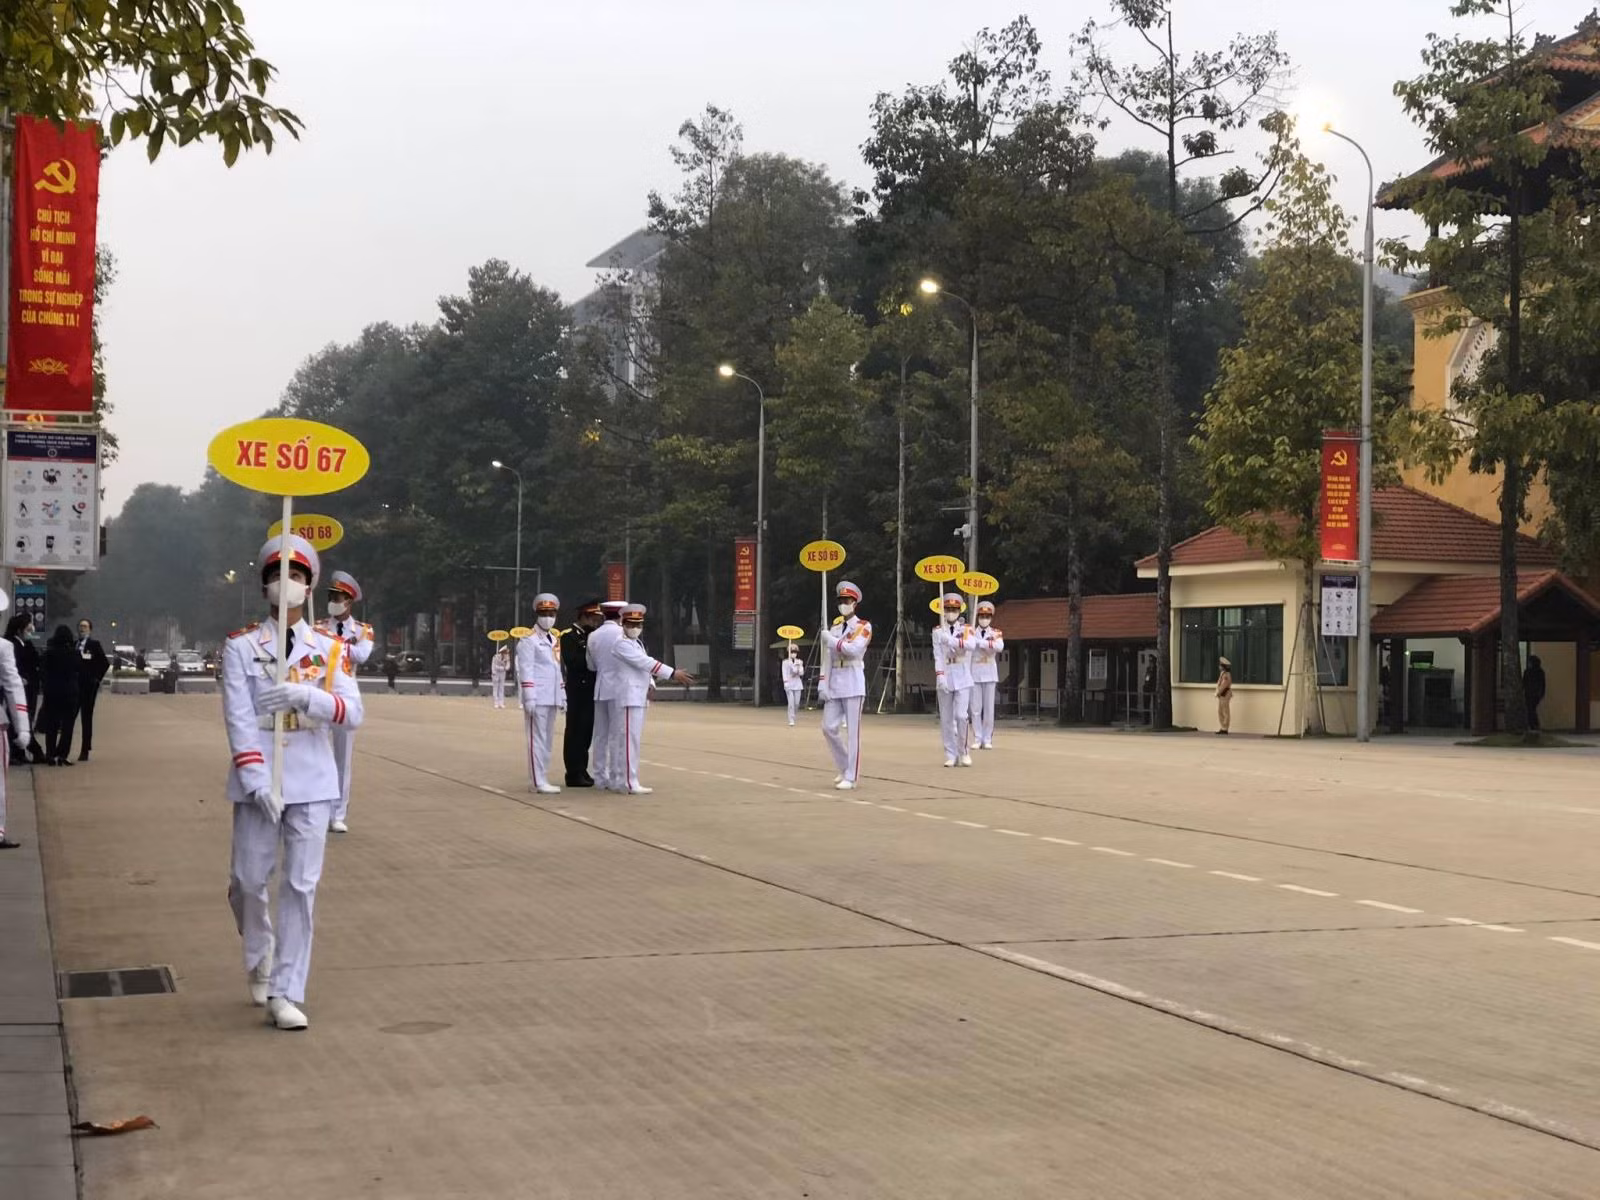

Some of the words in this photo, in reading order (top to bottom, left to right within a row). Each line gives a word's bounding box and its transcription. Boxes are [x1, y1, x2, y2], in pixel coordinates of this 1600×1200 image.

[54, 210, 70, 226] TỊCH
[56, 231, 76, 245] MINH
[19, 289, 43, 303] TRONG
[236, 440, 268, 467] XE
[276, 436, 311, 471] SỐ
[317, 446, 347, 473] 67
[318, 526, 332, 539] 68
[807, 551, 816, 561] XE
[830, 550, 839, 561] 69
[923, 564, 933, 574] XE
[948, 564, 957, 573] 70
[963, 578, 972, 587] XE
[984, 581, 992, 590] 71
